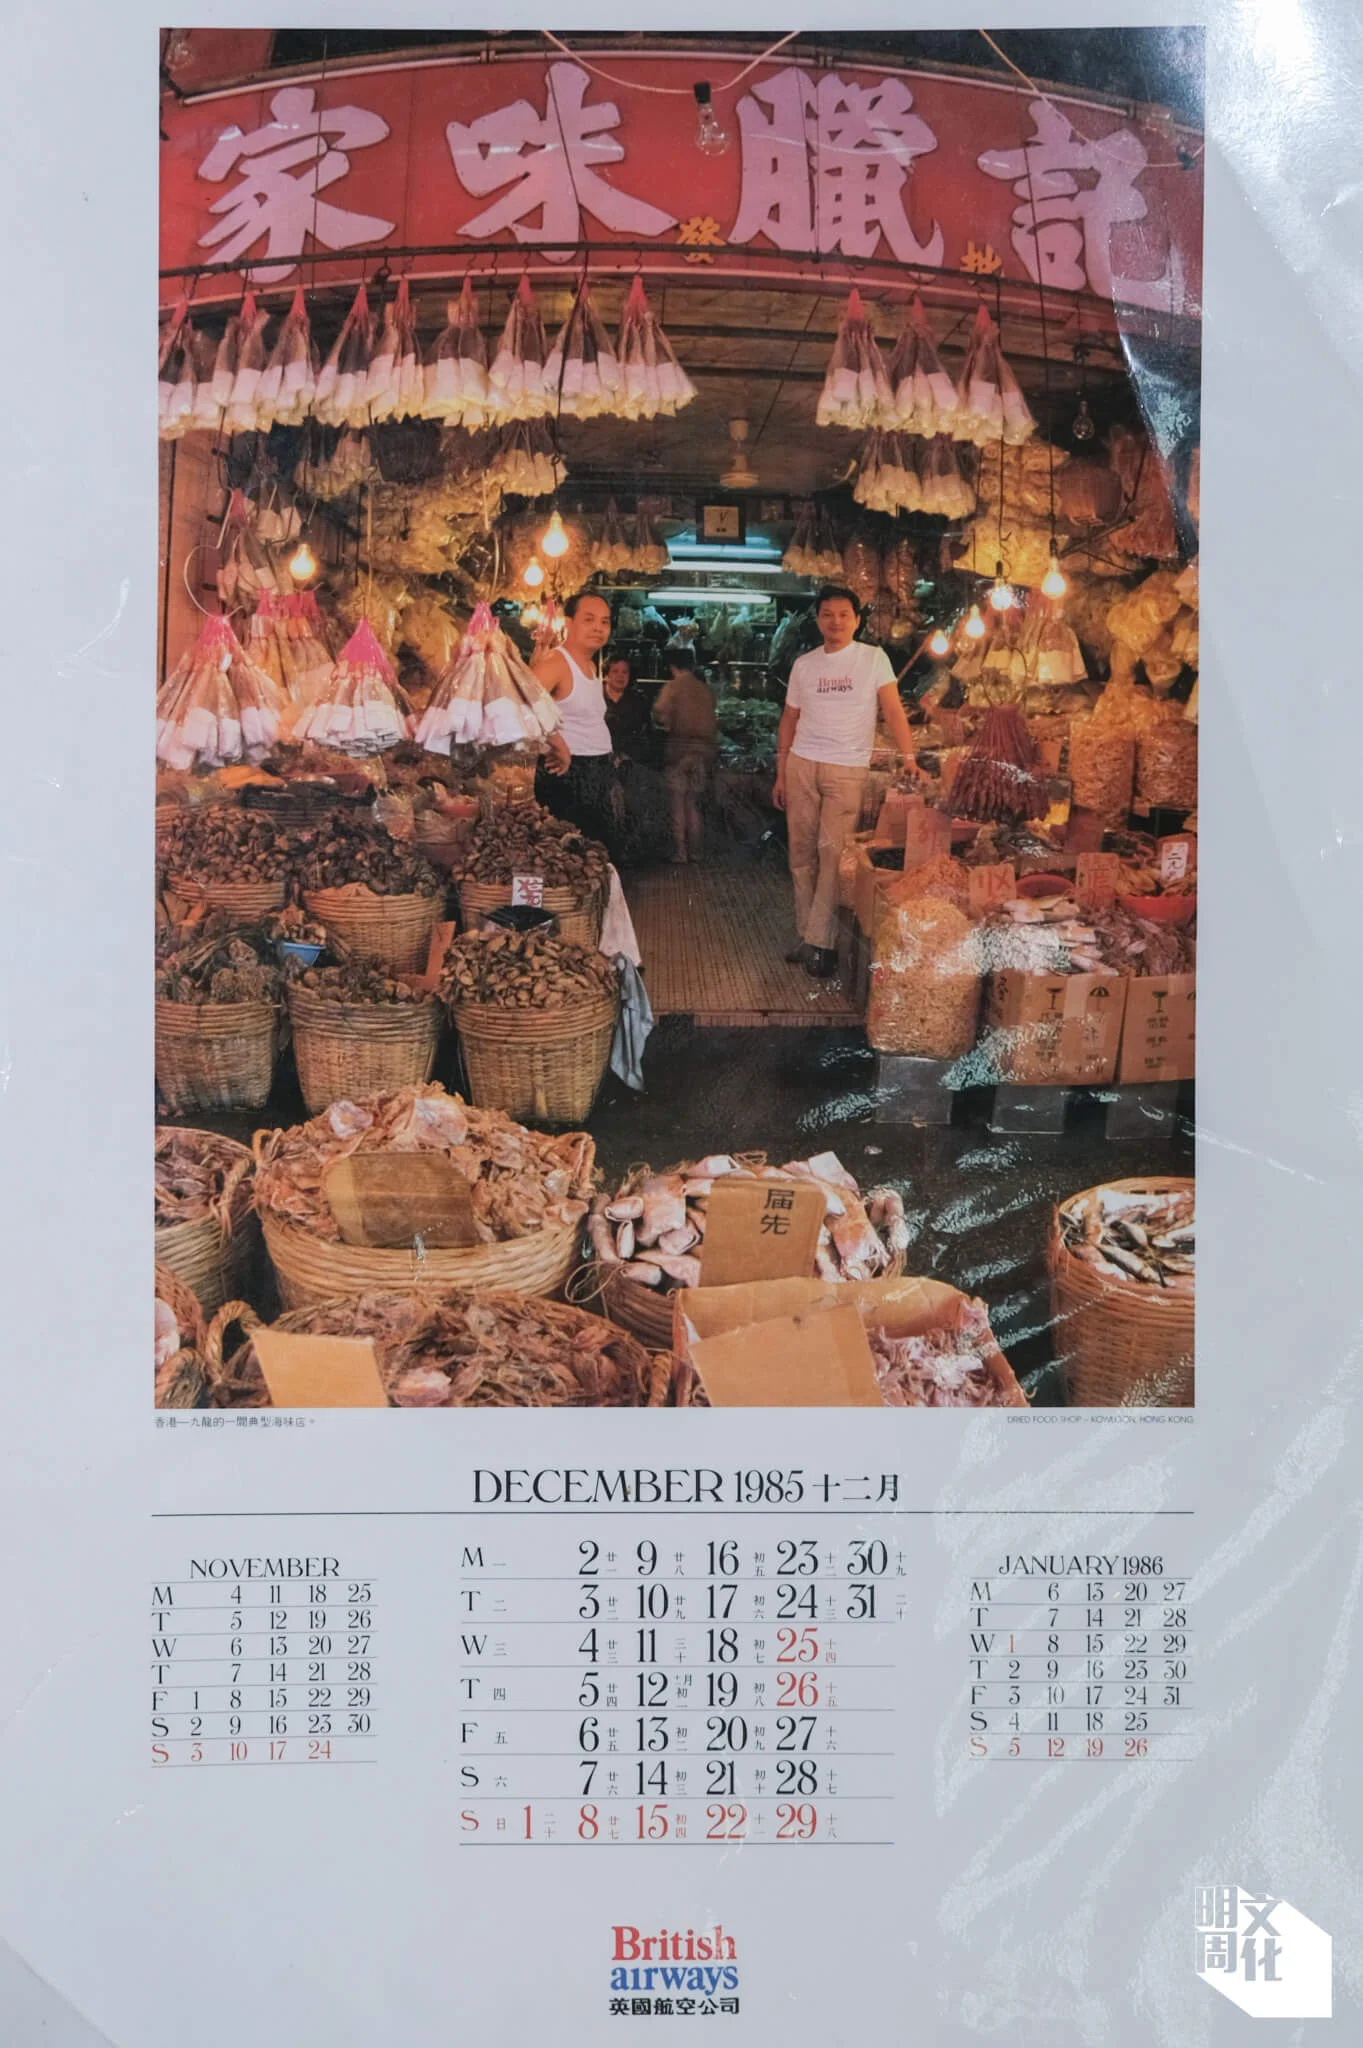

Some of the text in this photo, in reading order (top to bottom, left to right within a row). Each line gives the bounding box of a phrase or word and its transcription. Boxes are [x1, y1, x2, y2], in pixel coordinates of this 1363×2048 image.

[473, 1469, 898, 1503] DECEMBER 1985 十二月
[191, 1557, 339, 1579] NOVEMBER
[461, 1547, 484, 1567] M
[579, 1540, 599, 1575] 2
[637, 1540, 657, 1576] 9
[707, 1540, 739, 1576] 16
[777, 1540, 819, 1576] 23
[847, 1540, 888, 1575] 30
[999, 1555, 1163, 1575] JANUARY 1986
[152, 1583, 371, 1606] M 4 11 18 25
[461, 1591, 480, 1611] T
[579, 1584, 600, 1619] 3
[637, 1584, 669, 1619] 10
[707, 1584, 738, 1619] 17
[776, 1584, 818, 1619] 24
[847, 1584, 876, 1619] 31
[971, 1582, 1186, 1601] M 6 13 20 27
[152, 1609, 371, 1632] T 5 12 19 26
[970, 1608, 1186, 1628] T 7 14 21 28
[152, 1635, 370, 1658] W 6 13 20 27
[461, 1635, 487, 1655] W
[578, 1628, 599, 1663] 4
[637, 1628, 656, 1663] 11
[707, 1627, 738, 1663] 18
[777, 1628, 818, 1662] 25
[970, 1633, 1186, 1653] W 1 8 15 22 29
[151, 1662, 371, 1684] T 7 14 21 28
[970, 1659, 1186, 1680] T 2 9 16 23 30
[152, 1688, 370, 1711] F 1 8 15 22 29
[460, 1678, 480, 1699] T
[579, 1672, 599, 1707] 5
[637, 1672, 668, 1707] 12
[707, 1672, 738, 1707] 19
[776, 1672, 818, 1707] 26
[971, 1685, 1180, 1705] F 3 10 17 24 31
[152, 1714, 370, 1737] S 2 9 16 23 30
[970, 1711, 1148, 1731] S 4 11 18 25
[462, 1722, 478, 1743] F
[579, 1716, 599, 1752] 6
[636, 1716, 669, 1752] 13
[706, 1716, 748, 1751] 20
[776, 1716, 817, 1751] 27
[152, 1740, 330, 1762] S 3 10 17 24
[971, 1737, 1147, 1757] S 5 12 19 26
[461, 1766, 479, 1787] S
[579, 1760, 598, 1795] 7
[636, 1760, 668, 1795] 14
[706, 1760, 736, 1795] 21
[776, 1760, 817, 1795] 28
[461, 1811, 479, 1830] S
[524, 1805, 532, 1839] 1
[578, 1804, 598, 1839] 8
[636, 1804, 668, 1839] 15
[706, 1804, 747, 1839] 22
[776, 1804, 817, 1838] 29
[611, 1925, 737, 1961] British
[610, 1965, 739, 1996] airways
[609, 1998, 740, 2015] 英國航空公司
